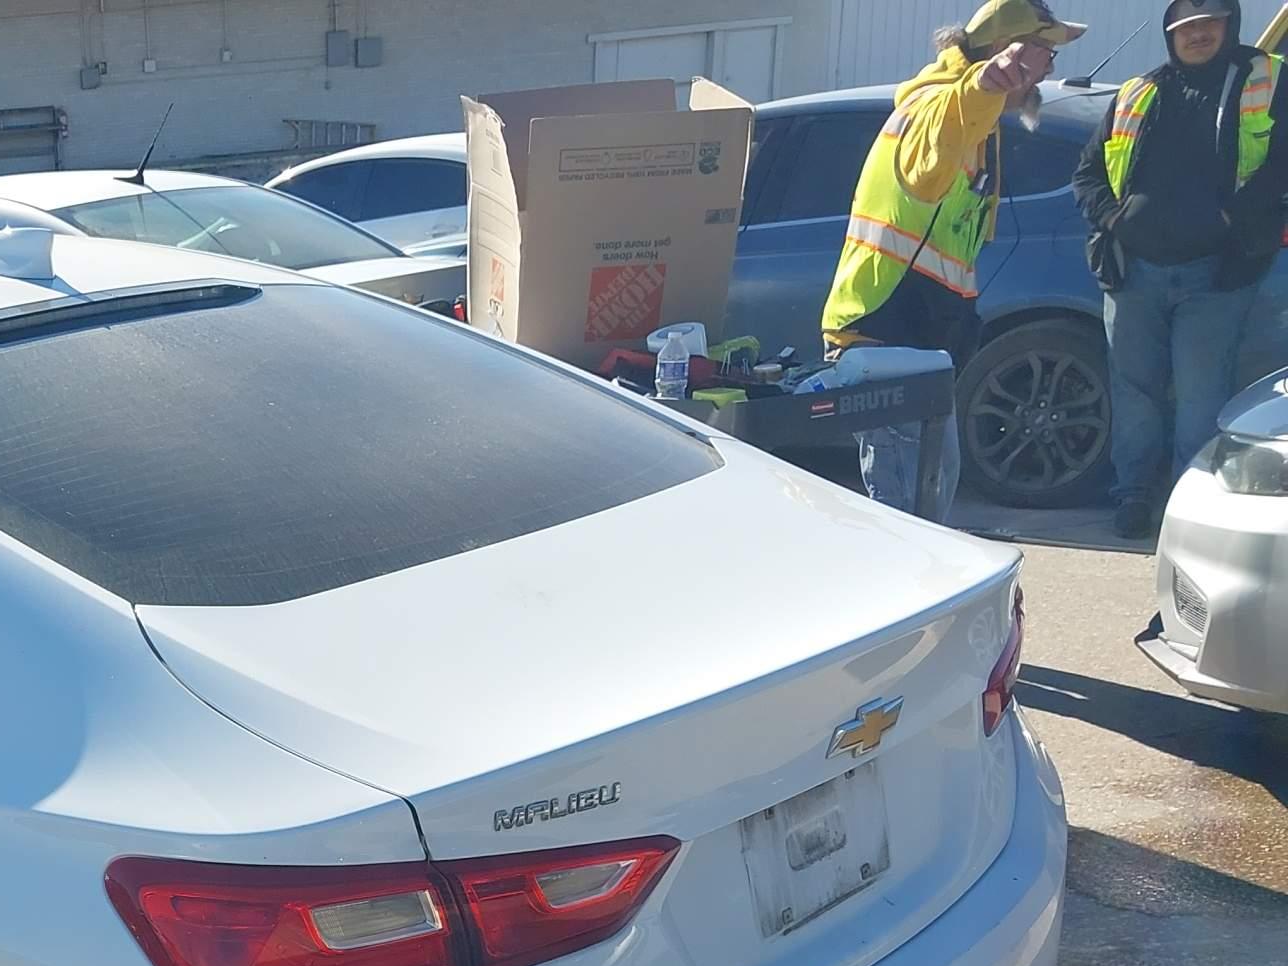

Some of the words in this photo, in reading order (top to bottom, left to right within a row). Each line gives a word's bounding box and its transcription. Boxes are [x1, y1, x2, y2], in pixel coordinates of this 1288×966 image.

[624, 240, 652, 249] more
[654, 236, 671, 248] get
[602, 252, 633, 262] doers
[635, 251, 659, 260] How
[586, 267, 664, 338] HOME
[839, 385, 905, 415] BRUTE
[493, 781, 621, 832] MALIBU
